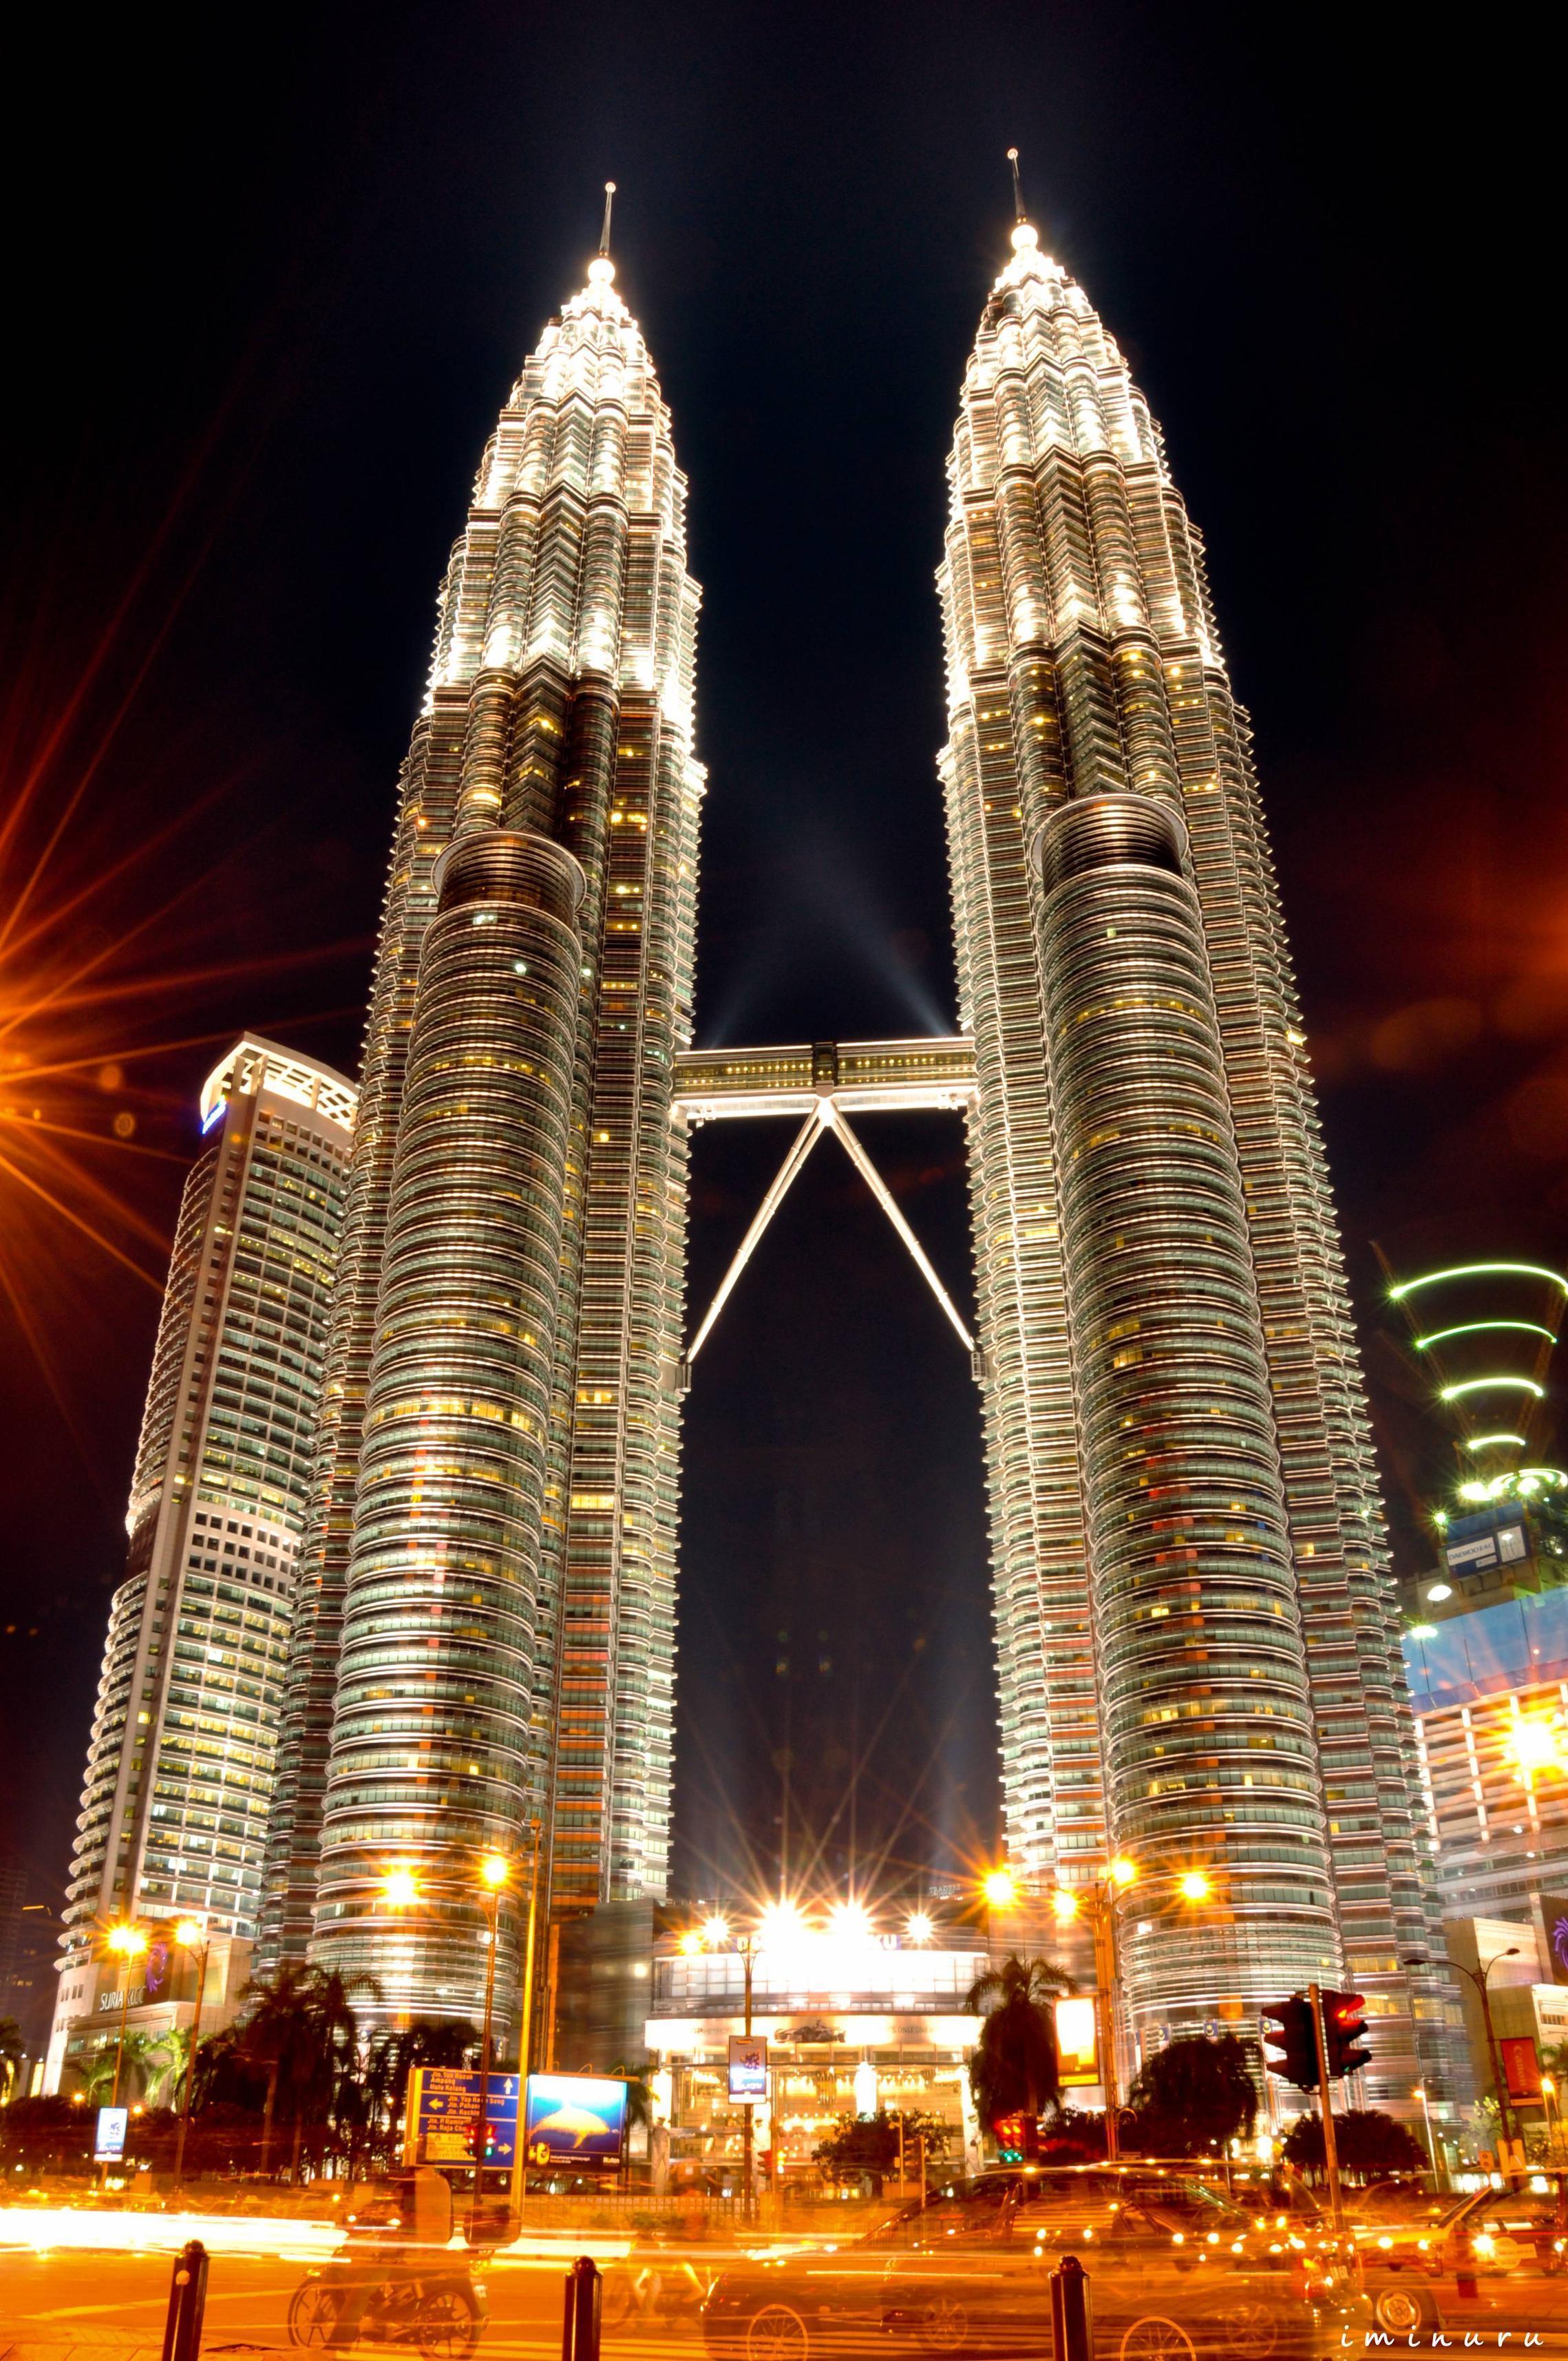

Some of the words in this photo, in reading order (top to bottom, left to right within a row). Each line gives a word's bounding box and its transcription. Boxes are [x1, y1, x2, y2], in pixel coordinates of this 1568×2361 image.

[1448, 1547, 1479, 1560] DAEWOO
[99, 1990, 123, 2011] SURIA
[127, 1987, 146, 2006] KLCC
[431, 2077, 456, 2086] Ampang
[489, 2098, 505, 2106] Seng
